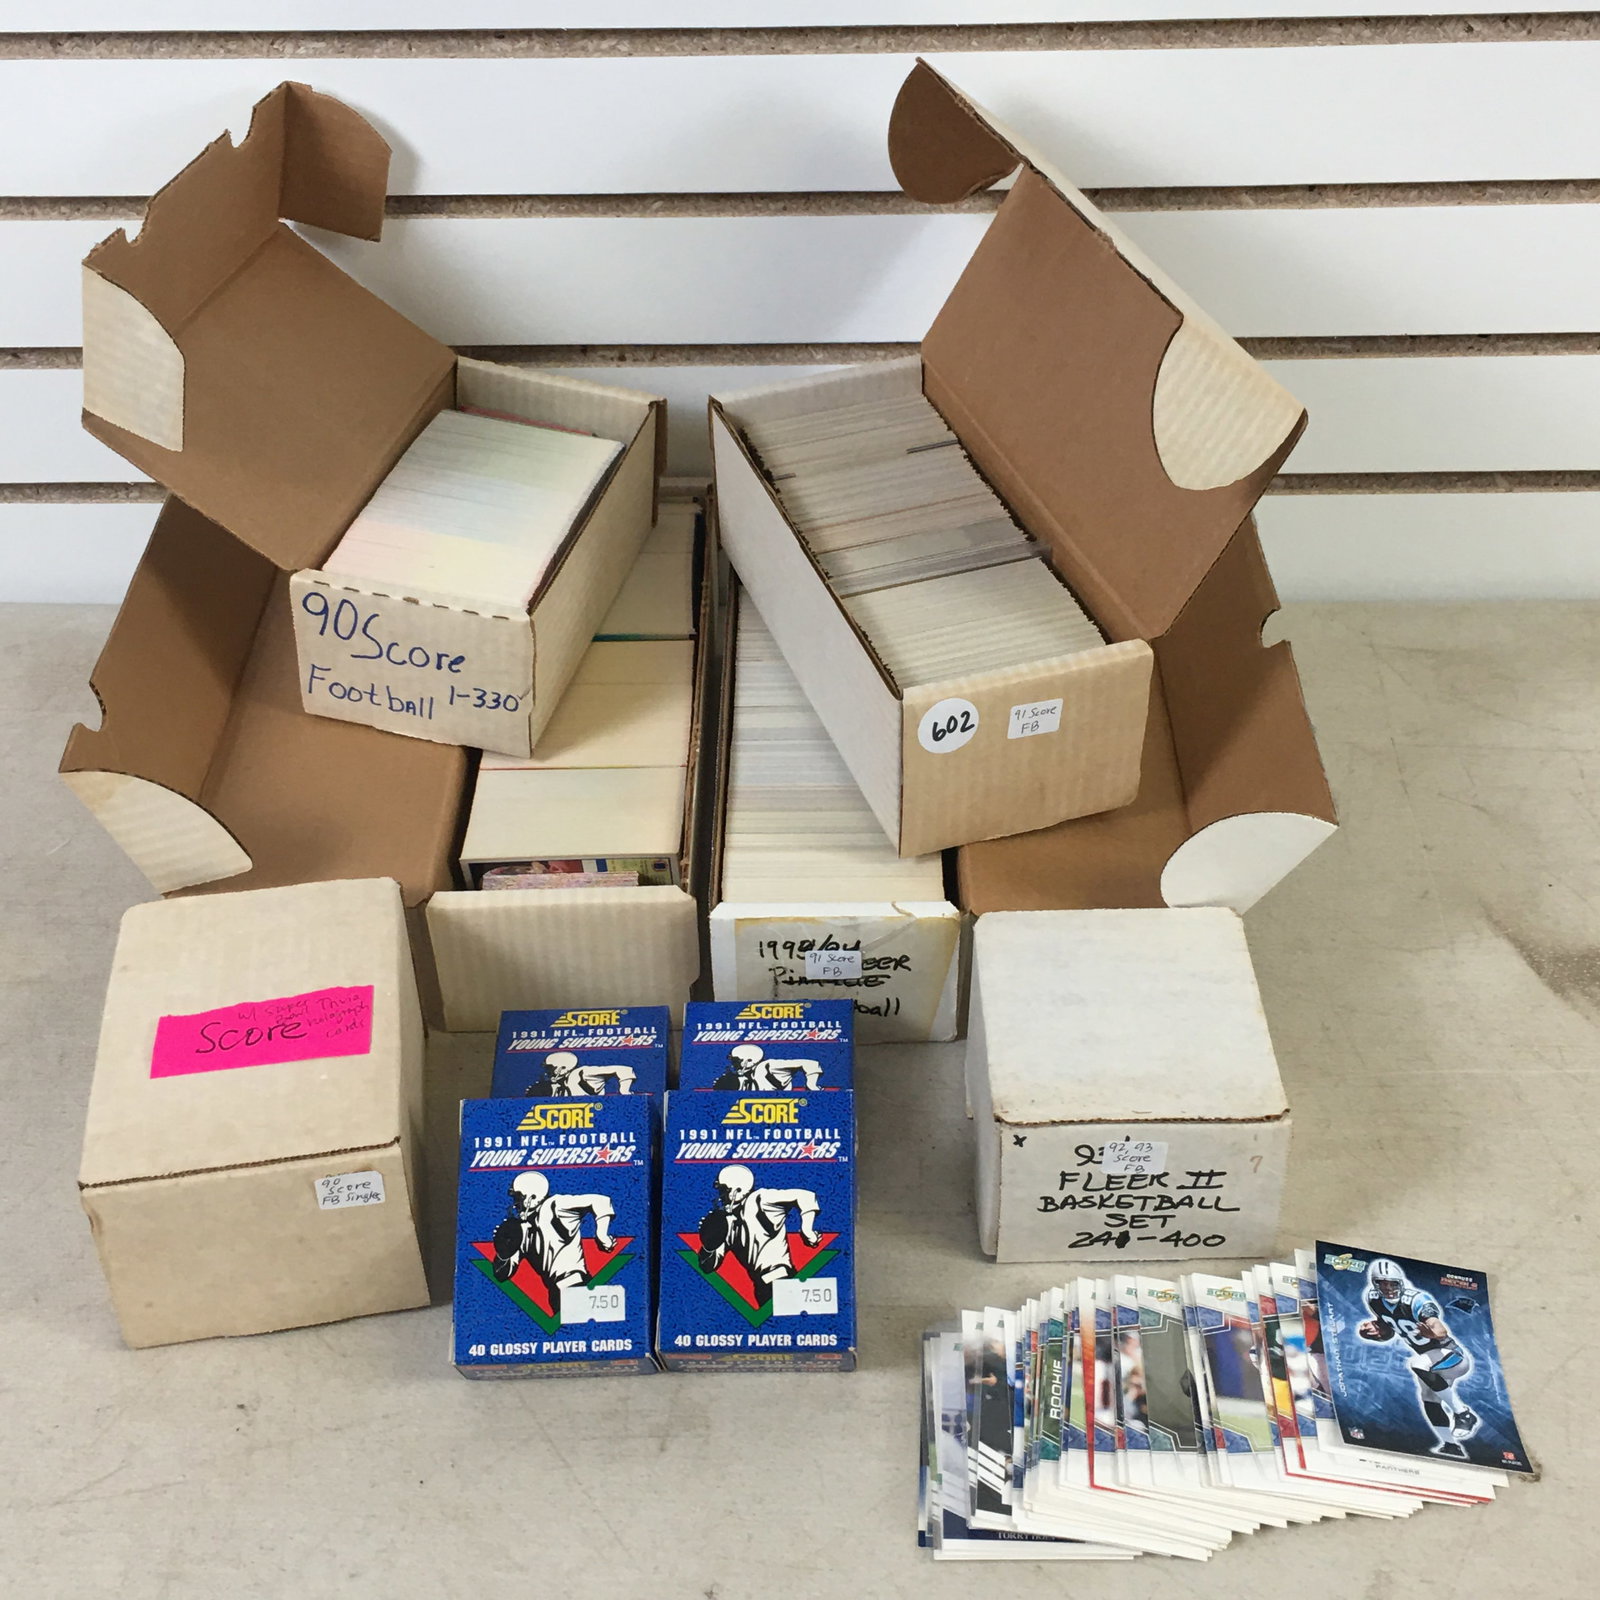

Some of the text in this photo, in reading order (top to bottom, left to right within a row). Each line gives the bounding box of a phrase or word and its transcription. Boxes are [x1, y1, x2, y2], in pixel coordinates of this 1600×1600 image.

[302, 591, 466, 673] 90 Score
[1015, 710, 1027, 720] 91
[932, 710, 975, 741] 602
[1021, 722, 1040, 734] FB
[809, 953, 822, 964] 91
[823, 966, 842, 976] FB
[550, 1009, 621, 1027] SCORE
[735, 1003, 804, 1020] SCORE
[588, 1027, 657, 1036] FOOTBALL
[773, 1020, 842, 1028] FOOTBALL
[196, 1022, 307, 1053] Score
[508, 1038, 555, 1050] YOUNG
[693, 1031, 740, 1042] YOUNG
[516, 1103, 595, 1130] SCORE
[721, 1098, 800, 1124] SCORE
[474, 1136, 512, 1148] 1991
[560, 1132, 636, 1145] FOOTBALL
[679, 1129, 717, 1140] 1991
[764, 1128, 841, 1140] FOOTBALL
[675, 1142, 731, 1159] YOUNG
[470, 1150, 527, 1168] YOUNG
[322, 1178, 341, 1188] 90
[322, 1196, 340, 1205] FB
[1037, 1194, 1240, 1212] BASKETBALL
[1104, 1213, 1176, 1229] SET
[589, 1294, 619, 1309] 7.50
[802, 1288, 832, 1302] 7.50
[469, 1339, 632, 1356] 40 GLOSSY PLAYER CARDS
[674, 1333, 838, 1347] 40 GLOSSY PLAYER CARDS
[1050, 1359, 1063, 1419] ROOKIE
